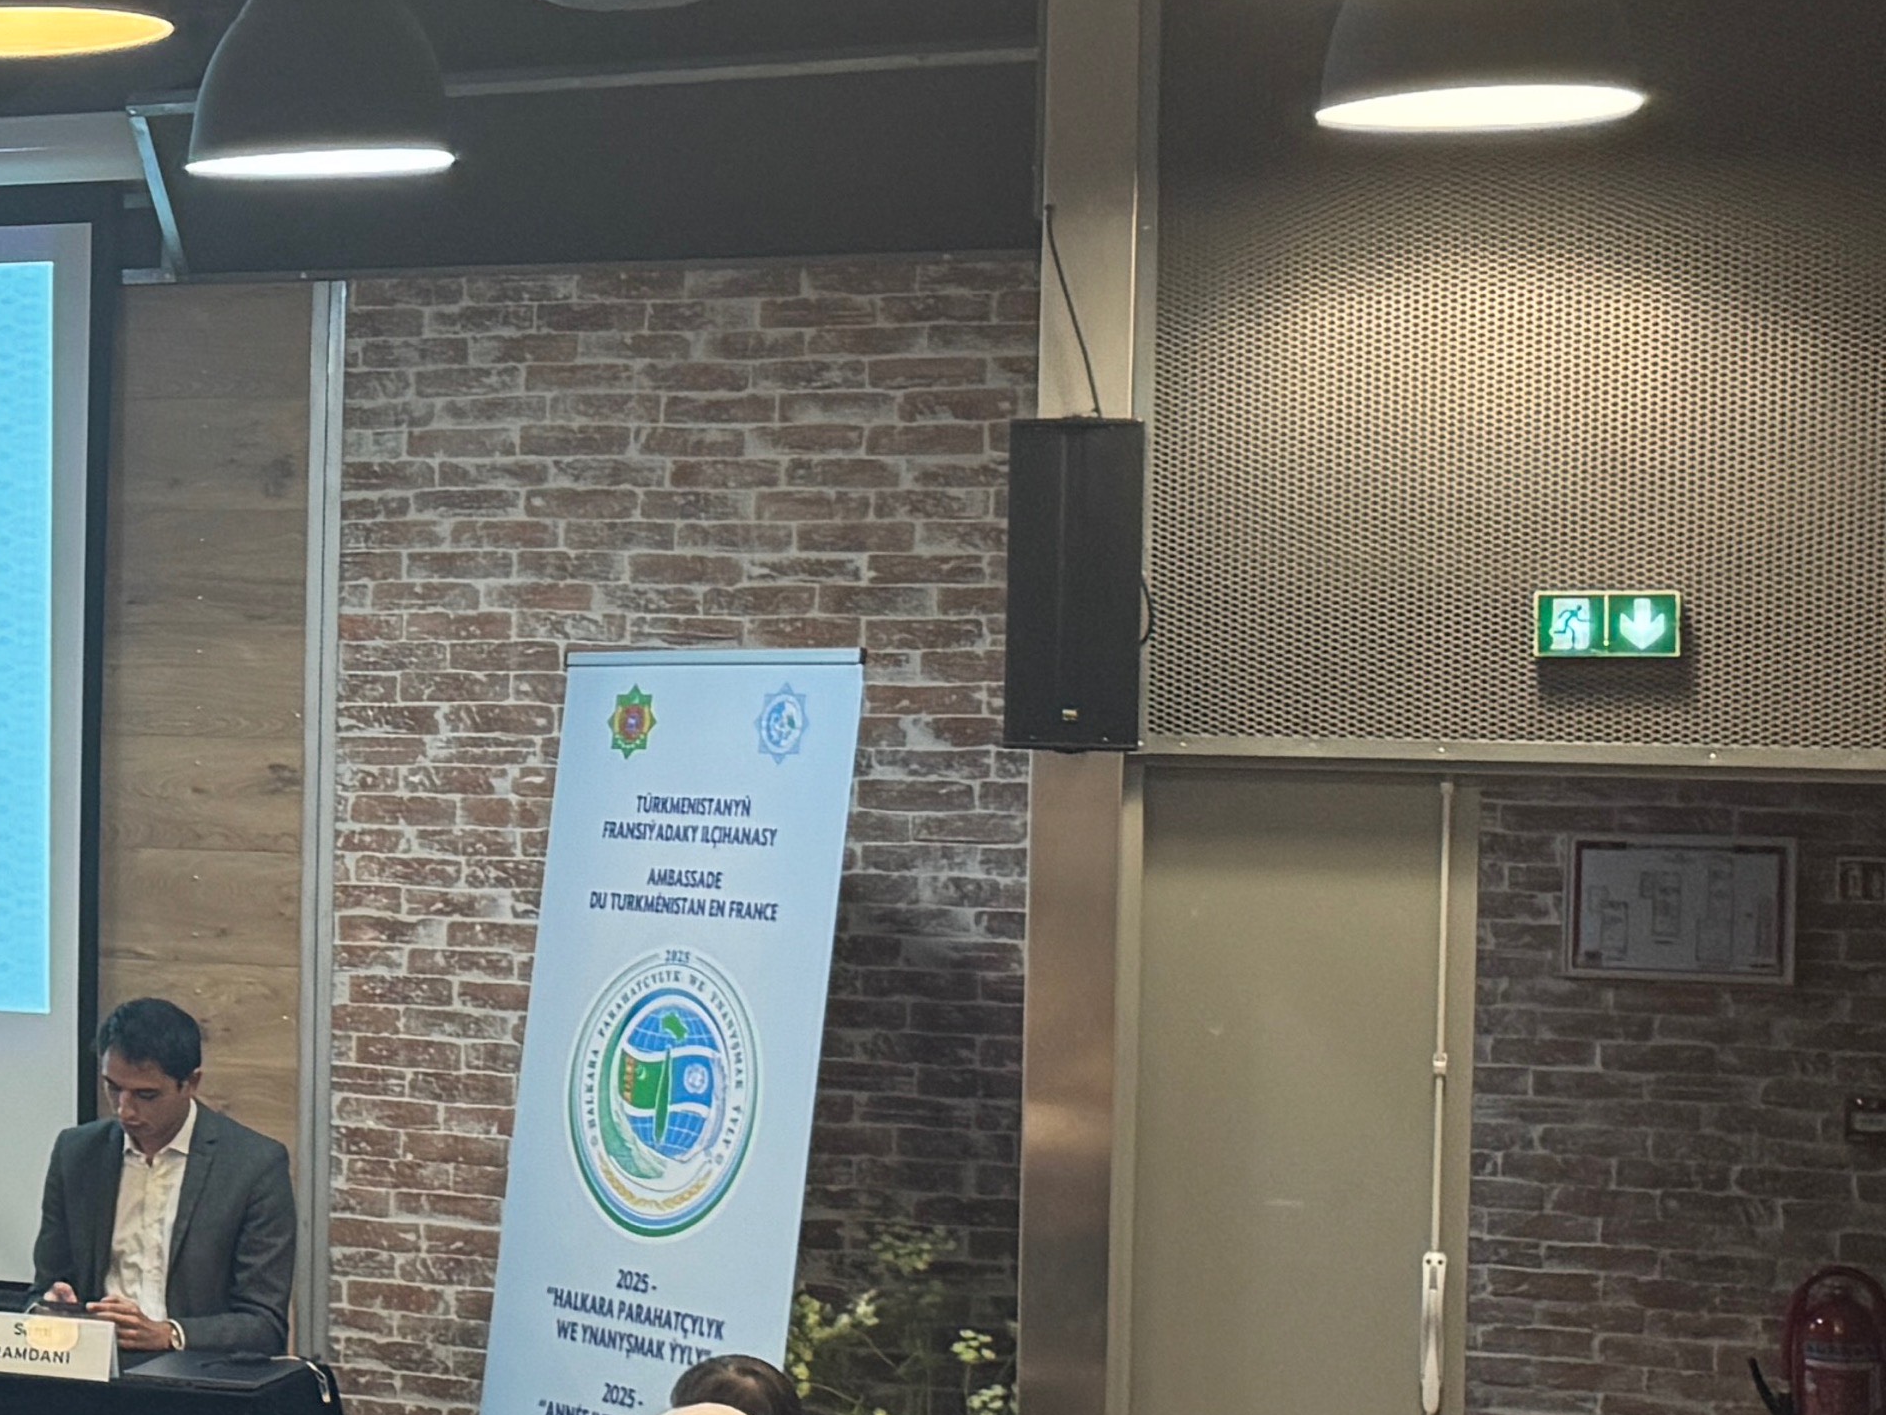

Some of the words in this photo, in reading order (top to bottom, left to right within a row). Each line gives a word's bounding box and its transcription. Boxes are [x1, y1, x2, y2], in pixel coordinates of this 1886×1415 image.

[647, 868, 723, 890] AMBASSADE
[590, 891, 607, 910] DU
[610, 892, 706, 916] TURKMÉNISTAN
[709, 899, 726, 918] EN
[729, 901, 778, 922] FRANCE
[665, 949, 691, 964] 2025
[616, 1269, 649, 1293] 2025
[617, 1299, 725, 1340] PARAHATÇYLYK
[556, 1319, 578, 1341] WE
[581, 1324, 666, 1359] YNANYŞMAK
[601, 1383, 637, 1408] 2025
